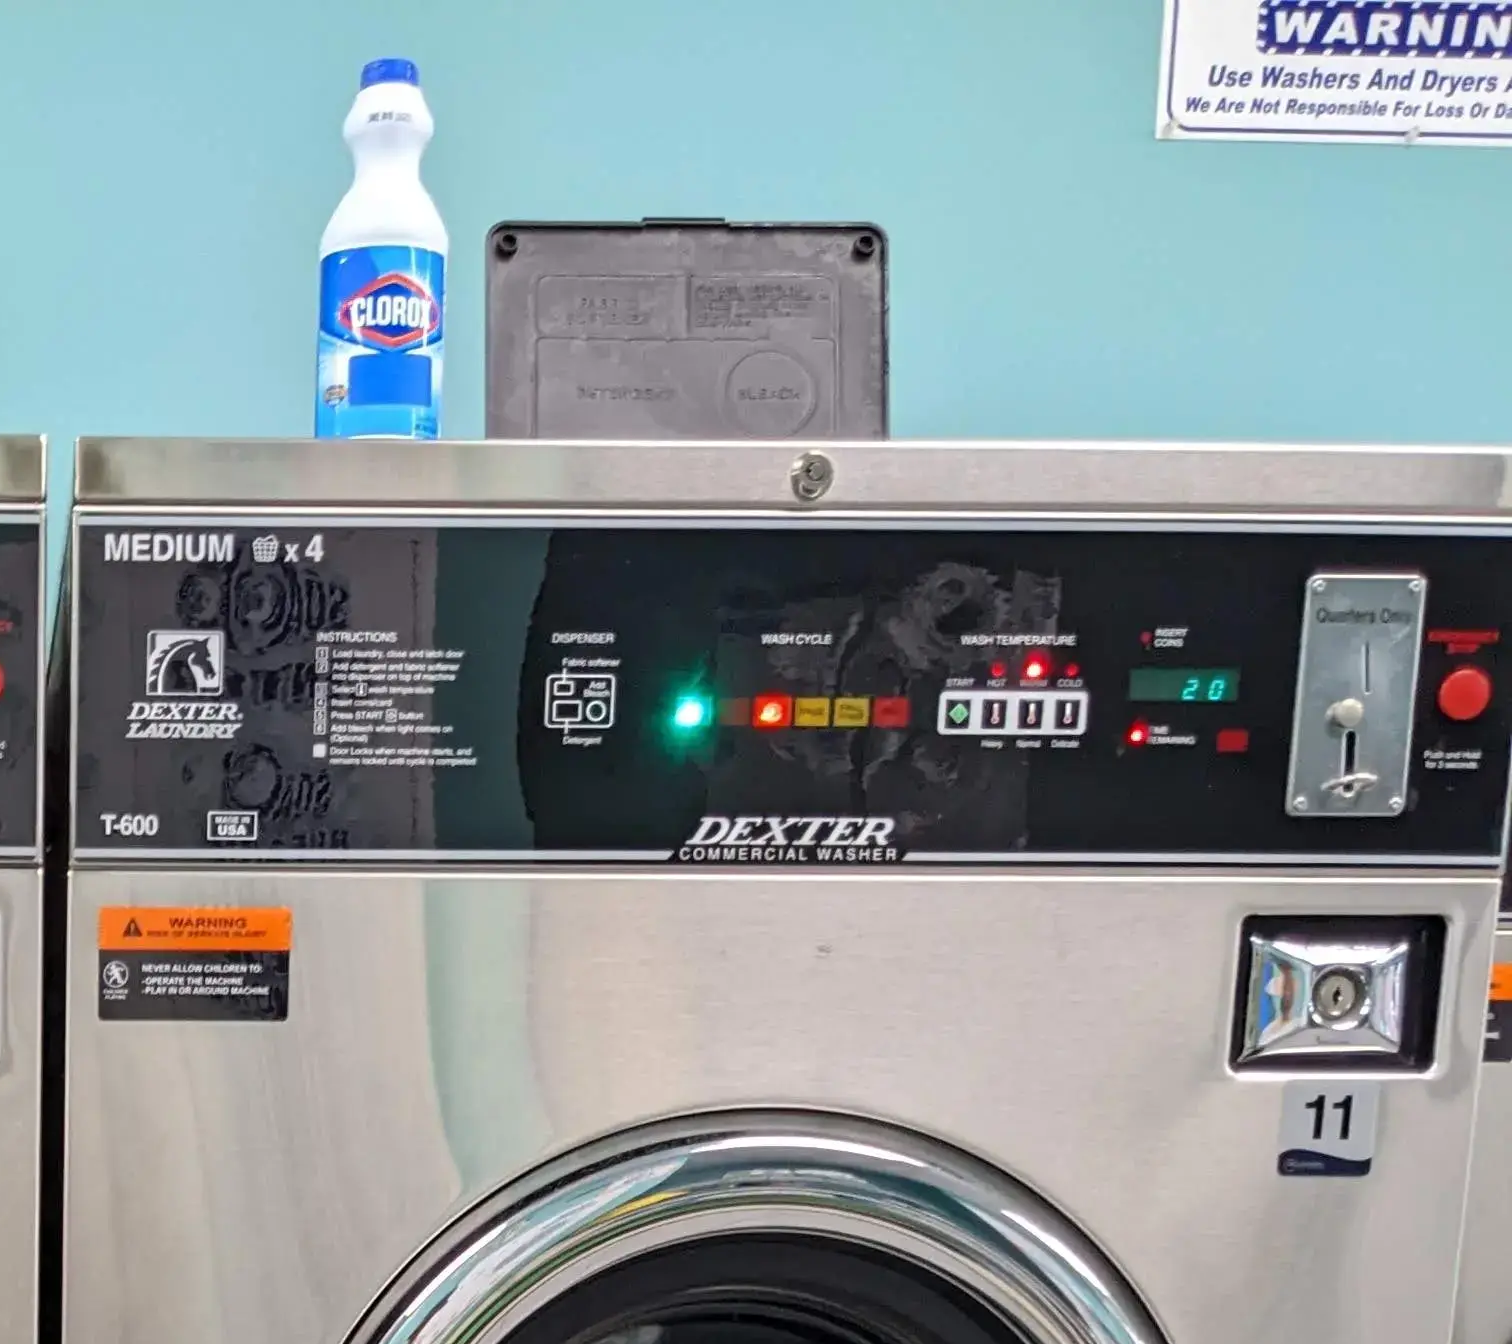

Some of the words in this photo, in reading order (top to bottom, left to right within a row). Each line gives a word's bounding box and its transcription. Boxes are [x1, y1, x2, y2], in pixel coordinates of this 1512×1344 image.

[1208, 65, 1252, 88] Use
[1261, 66, 1360, 90] Washers
[1366, 68, 1415, 91] And
[1421, 70, 1497, 98] Dryers
[1186, 97, 1210, 113] We
[1215, 97, 1243, 114] Are
[1250, 98, 1280, 115] Not
[1287, 99, 1387, 117] Responsible
[1393, 101, 1419, 117] For
[1425, 102, 1463, 118] Loss
[1470, 102, 1491, 119] Or
[351, 296, 430, 328] CLOROX
[104, 534, 234, 562] MEDIUM
[284, 543, 299, 562] x
[305, 534, 324, 562] 4
[316, 632, 397, 643] INSTRUCTIONS
[552, 633, 615, 644] DISPENSER
[761, 634, 795, 644] WASH
[796, 634, 832, 645] CYCLE
[961, 635, 994, 645] WASH
[997, 635, 1077, 646] TEMPERATURE
[126, 702, 238, 720] DEXTER
[126, 722, 243, 739] LAUNDRY
[100, 814, 159, 836] T-600
[217, 824, 246, 836] USA
[685, 816, 896, 846] DEXTER
[679, 848, 808, 861] COMMERCIAL
[816, 848, 897, 862] WASHER
[169, 917, 247, 929] WARNING
[1305, 1095, 1352, 1139] 11
